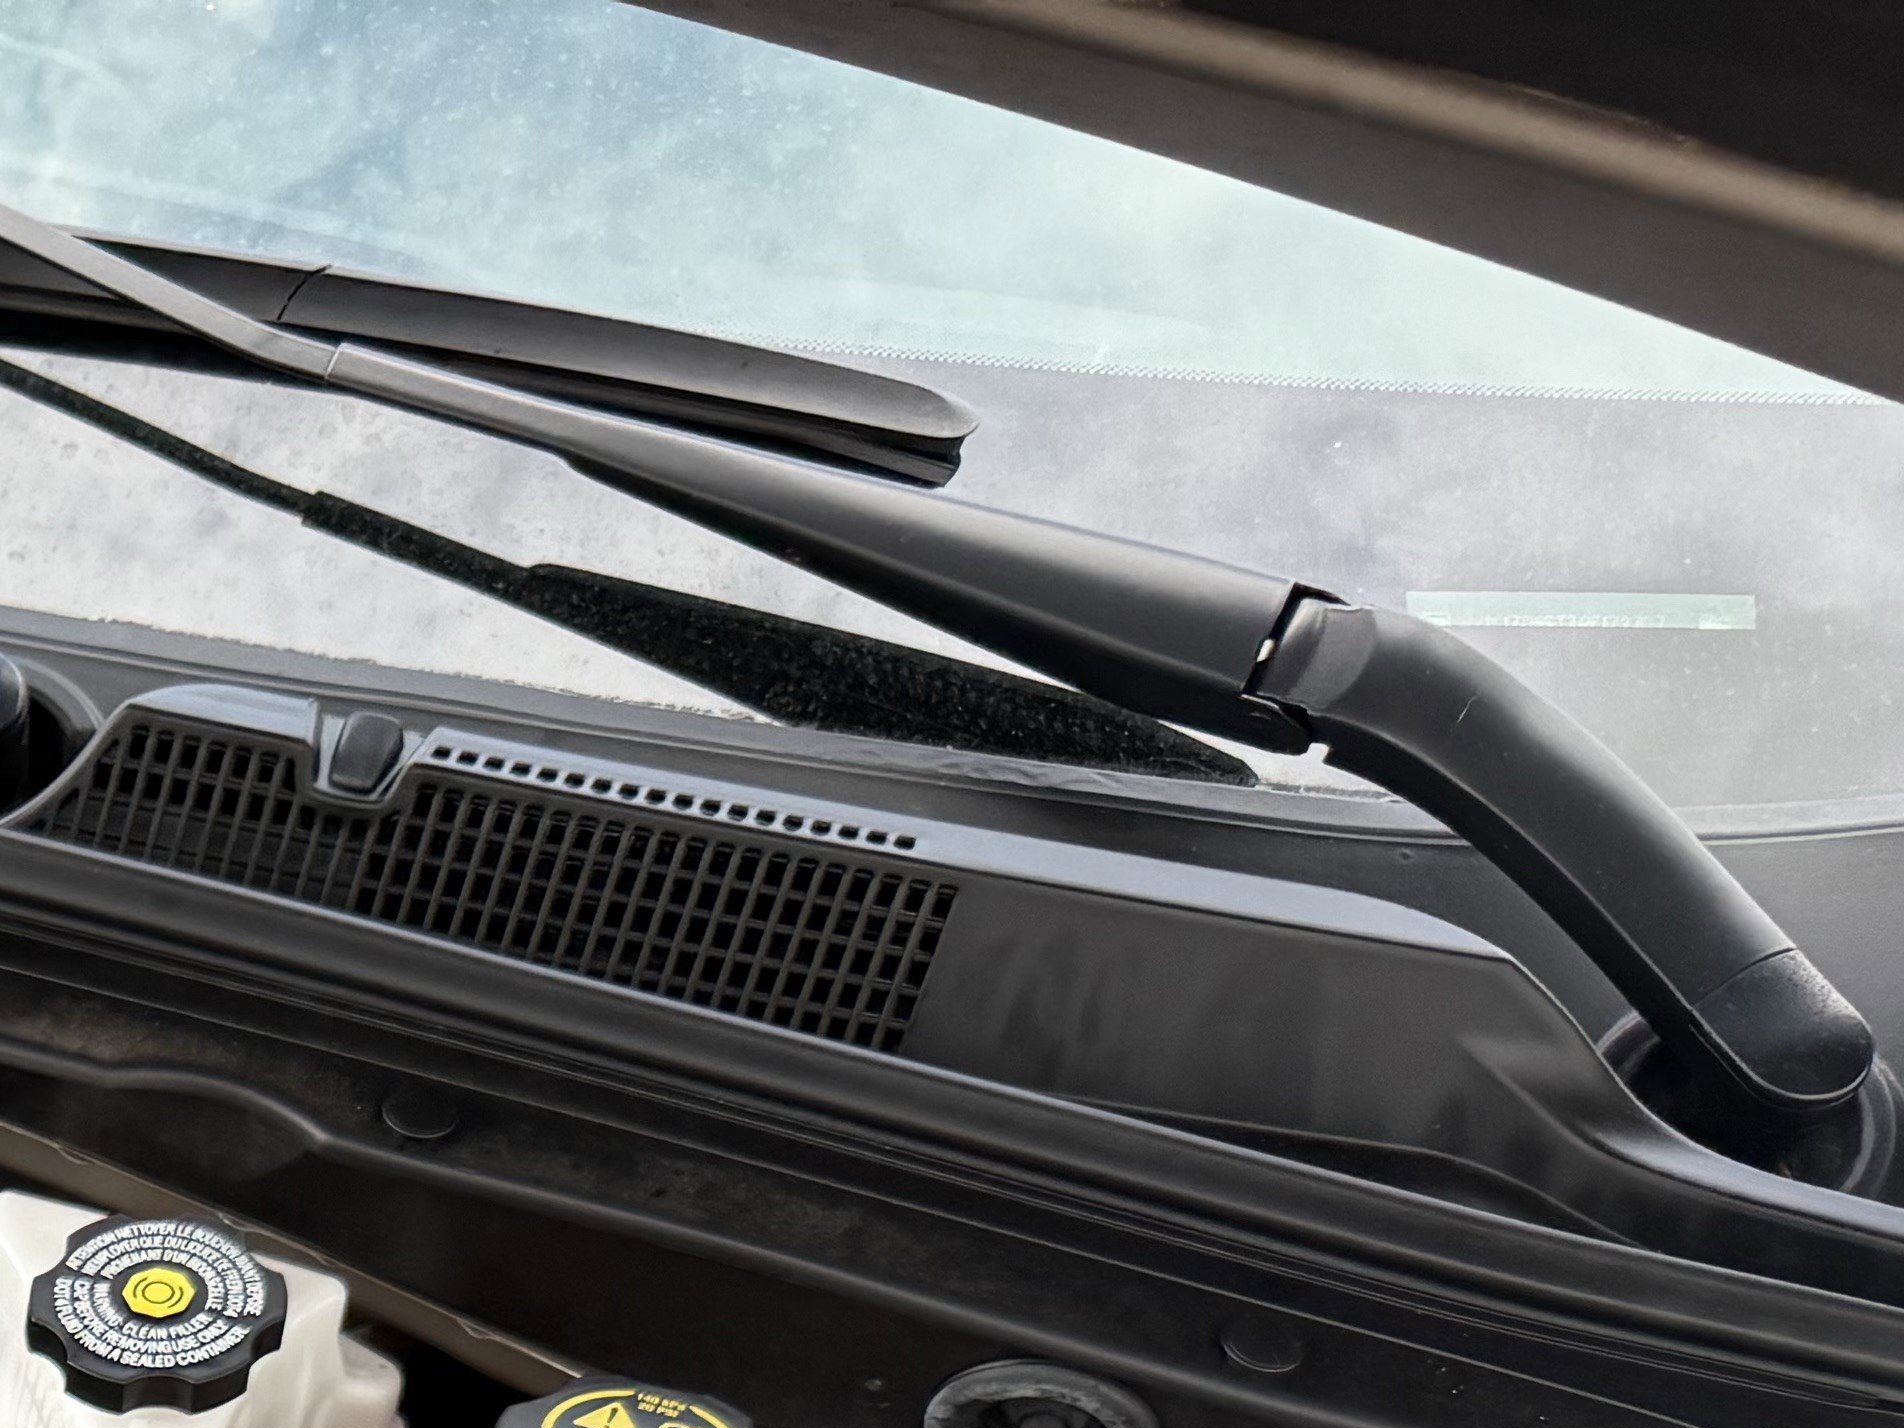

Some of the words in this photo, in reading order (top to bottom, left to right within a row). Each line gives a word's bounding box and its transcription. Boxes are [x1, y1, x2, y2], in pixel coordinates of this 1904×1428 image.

[115, 1223, 176, 1239] NETTOYER
[177, 1224, 194, 1234] LE
[139, 1236, 163, 1246] QUE
[164, 1237, 183, 1248] DU
[73, 1279, 90, 1300] CAP
[74, 1298, 110, 1335] BEFORE
[121, 1323, 168, 1339] CLEAN
[168, 1312, 214, 1338] FILLER
[55, 1304, 85, 1333] FLUID
[74, 1330, 113, 1355] FROM
[109, 1348, 121, 1360] A
[121, 1350, 175, 1367] SEALED
[101, 1329, 171, 1351] REMOVING
[196, 1319, 229, 1343] ONLY
[172, 1336, 201, 1351] USE
